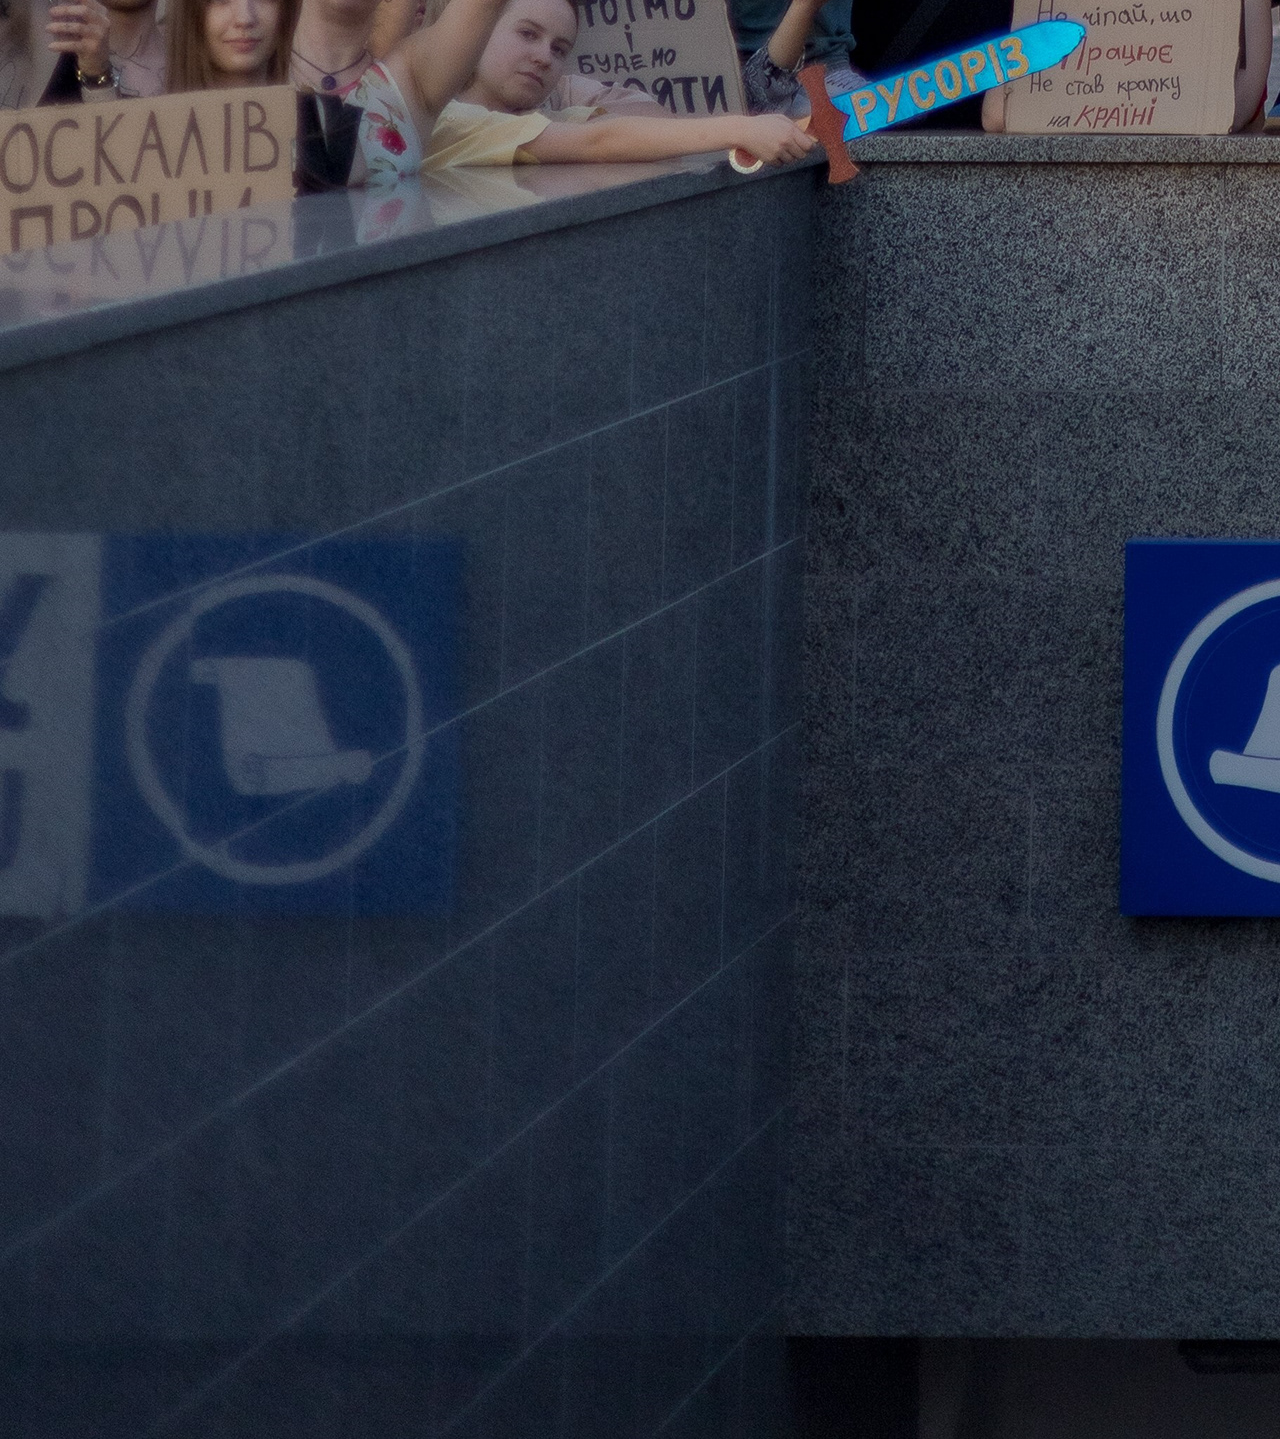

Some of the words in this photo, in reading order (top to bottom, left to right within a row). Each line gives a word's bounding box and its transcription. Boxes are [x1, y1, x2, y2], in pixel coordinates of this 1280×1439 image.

[1083, 3, 1154, 25] чіпай,
[577, 48, 676, 75] БУДЕМО
[850, 38, 1030, 134] РУСОРІЗ
[1030, 72, 1053, 94] Не
[1066, 74, 1104, 95] став
[1118, 75, 1181, 100] крапку
[1047, 115, 1070, 128] на
[2, 100, 280, 194] ОСКАЛІВ
